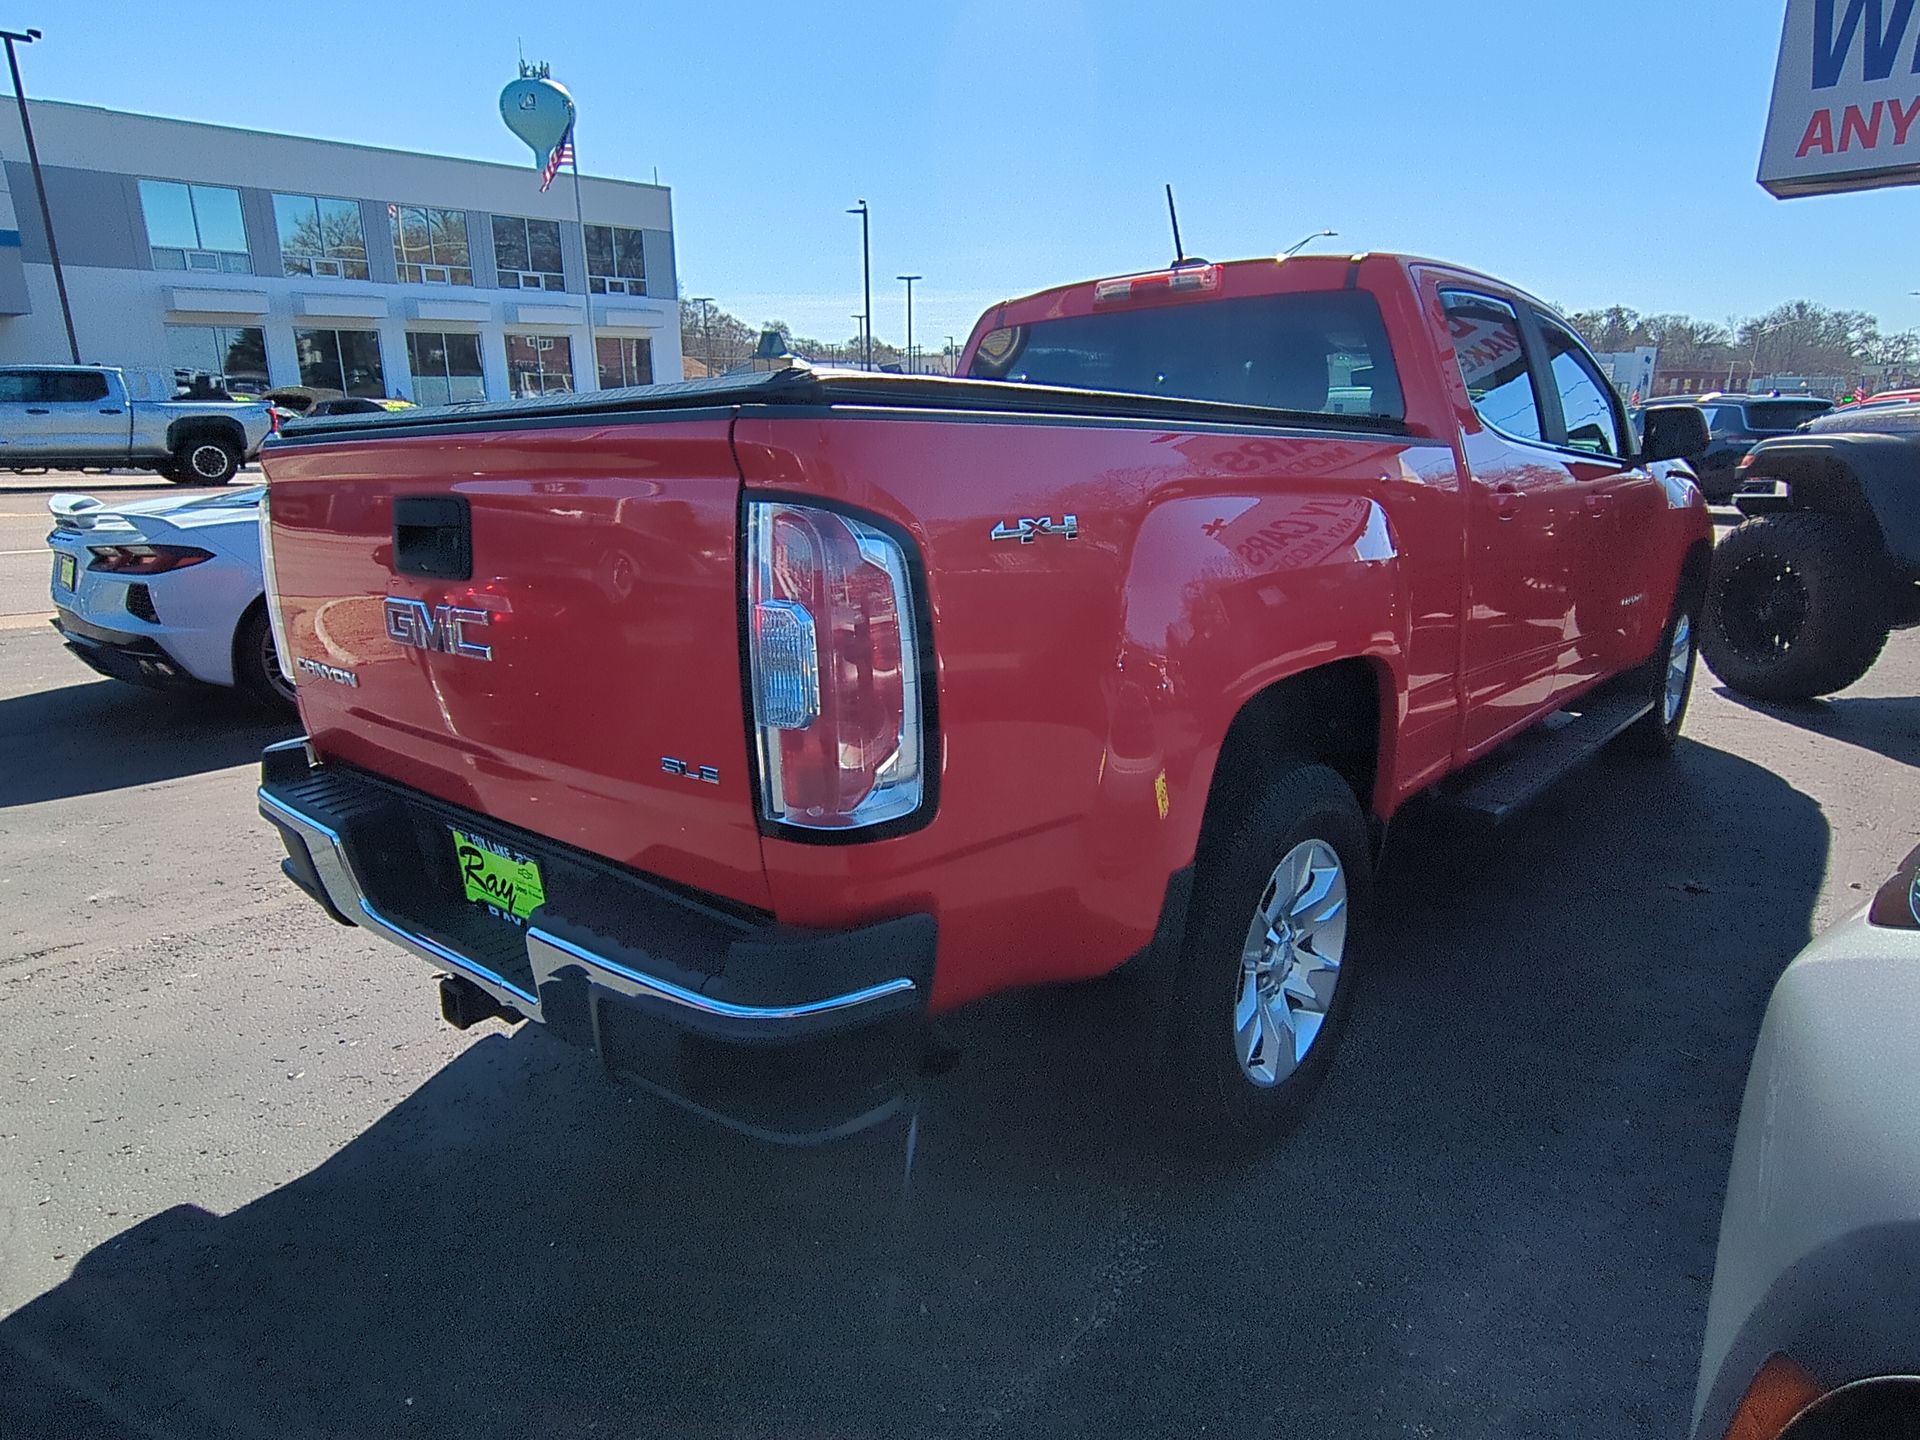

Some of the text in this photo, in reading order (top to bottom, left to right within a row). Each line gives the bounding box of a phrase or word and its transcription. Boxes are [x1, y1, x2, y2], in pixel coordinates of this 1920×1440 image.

[1795, 96, 1920, 158] ANY
[384, 596, 492, 662] GMC
[297, 656, 359, 688] CANYON
[661, 756, 720, 785] SLE
[459, 845, 517, 914] Ray
